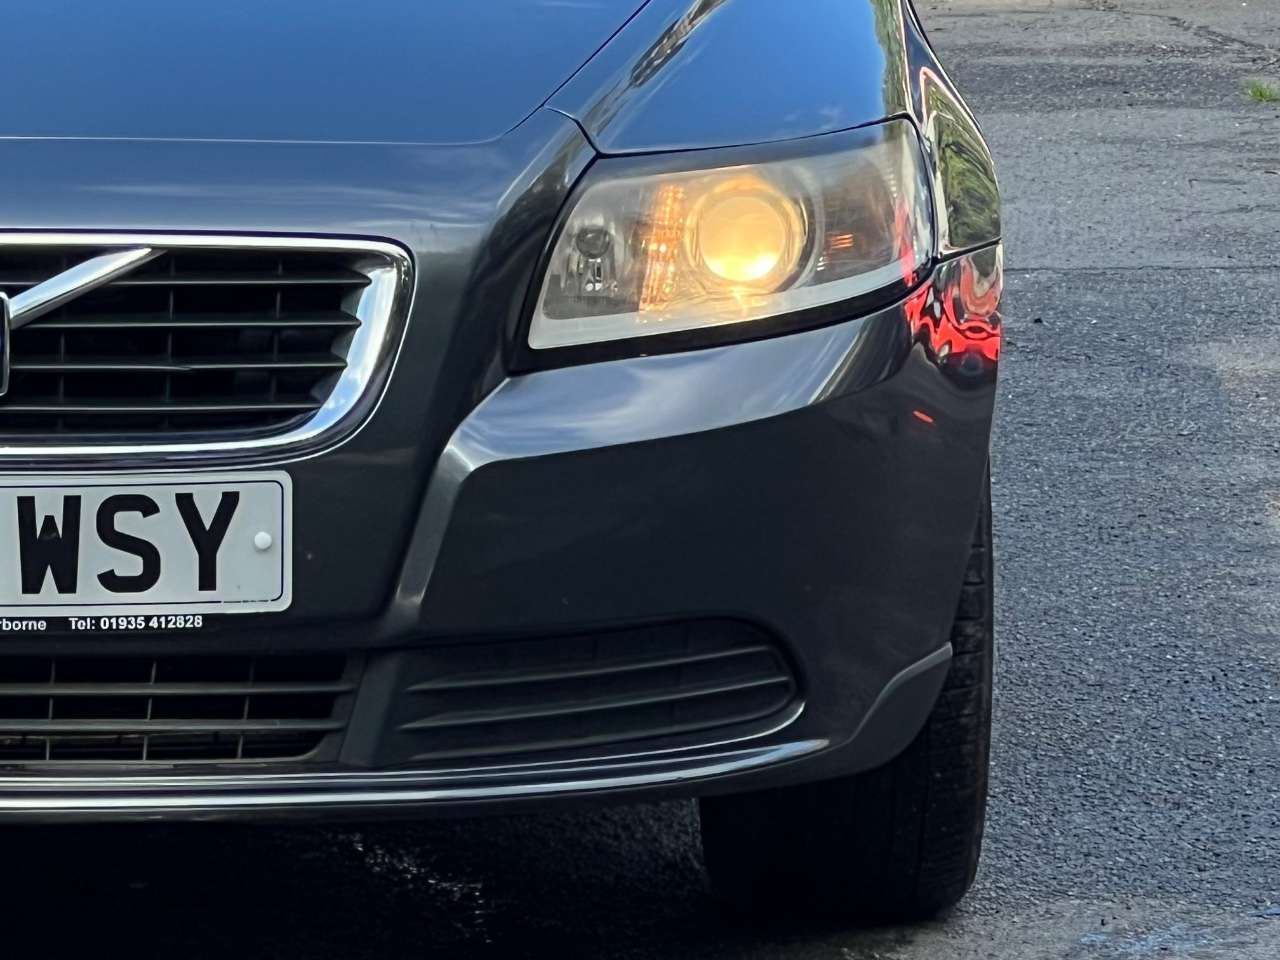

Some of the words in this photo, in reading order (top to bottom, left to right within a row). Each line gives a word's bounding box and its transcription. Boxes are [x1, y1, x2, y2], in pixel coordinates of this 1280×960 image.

[17, 491, 241, 595] WSY
[68, 616, 96, 630] Tel:
[100, 616, 146, 630] 01935
[148, 615, 204, 628] 412828
